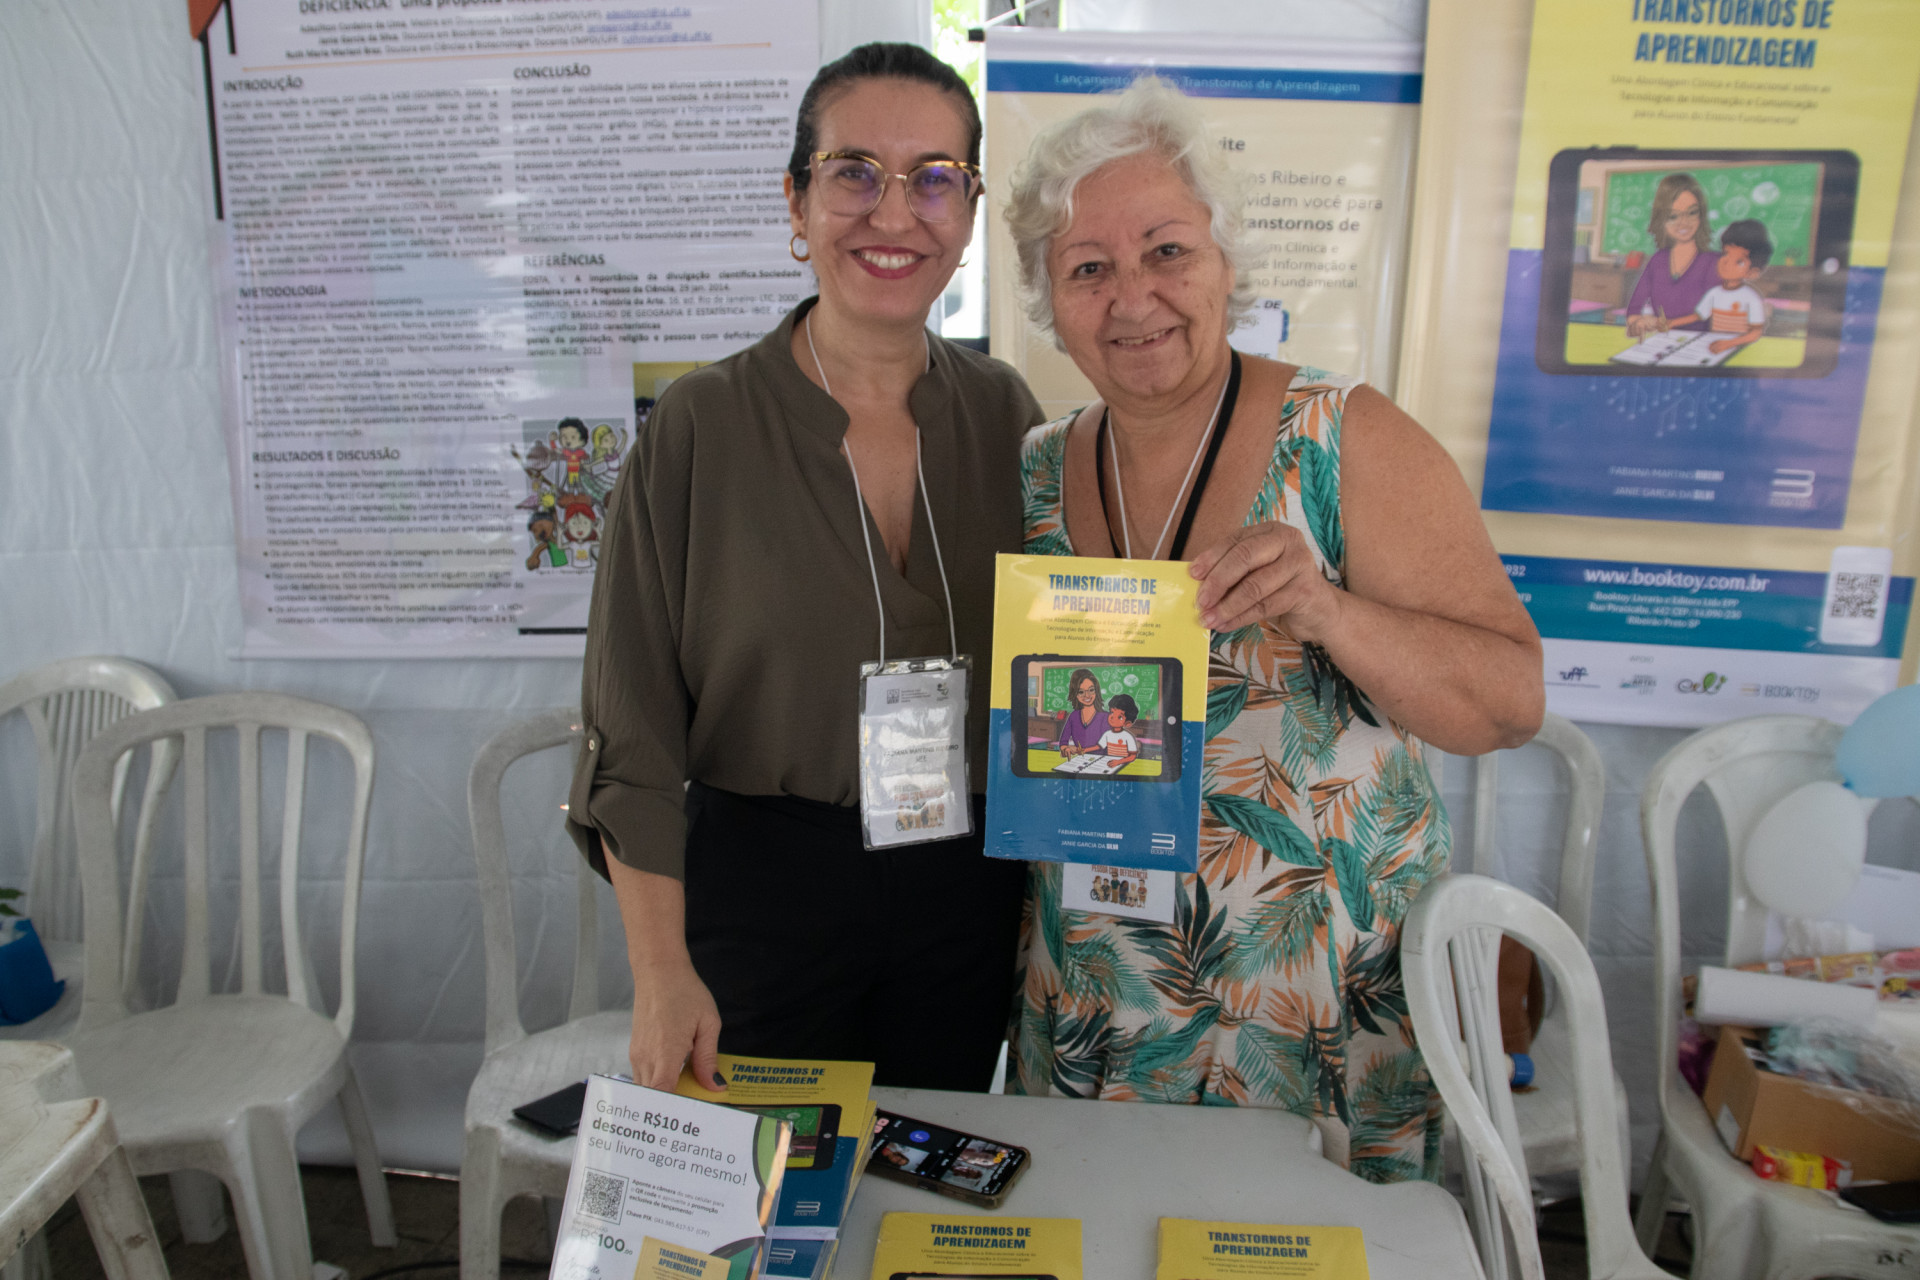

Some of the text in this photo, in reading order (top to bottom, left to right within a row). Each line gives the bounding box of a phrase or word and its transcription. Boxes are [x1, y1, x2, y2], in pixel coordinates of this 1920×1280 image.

[1631, 0, 1835, 28] TRANSTORNOS DE
[1634, 31, 1818, 69] APRENDIZAGEM
[513, 62, 591, 79] CONCLUSÃO
[222, 75, 304, 91] INTRODUÇÃO
[1055, 73, 1131, 88] Lançamento
[1183, 77, 1253, 90] Transtornos
[1256, 79, 1272, 90] de
[1274, 80, 1361, 95] Aprendizagem
[1272, 170, 1332, 185] Ribeiro
[1336, 175, 1346, 185] e
[1304, 194, 1342, 209] você
[1347, 197, 1384, 211] para
[1339, 218, 1360, 231] de
[1285, 241, 1327, 253] Clínica
[523, 253, 605, 267] REFERÊNCIAS
[1273, 258, 1359, 272] Informação e
[239, 284, 328, 297] METODOLOGIA
[252, 449, 323, 462] RESULTADOS
[335, 446, 400, 461] DISCUSSÃO
[1048, 574, 1157, 595] TRANSTORNOS DE
[1584, 566, 1770, 593] www.booktoy.com.br
[1052, 594, 1150, 615] APRENDIZAGEM
[1764, 684, 1820, 701] BOOKTOY
[1057, 828, 1080, 837] FABIANA
[732, 1063, 825, 1076] TRANSTORNOS DE
[731, 1073, 818, 1084] APRENDIZAGEM
[596, 1099, 700, 1137] Ganhe R$10 de
[592, 1116, 736, 1164] desconto e garanta o
[588, 1135, 747, 1187] seu livro agora mesmo!
[631, 1179, 651, 1189] Aponte
[656, 1184, 676, 1195] câmera
[712, 1198, 725, 1207] para
[635, 1186, 644, 1194] QR
[644, 1189, 657, 1198] code
[691, 1203, 719, 1215] promoção
[653, 1200, 660, 1208] de
[626, 1209, 642, 1218] Chave
[930, 1224, 1031, 1237] TRANSTORNOS DE
[1208, 1231, 1312, 1246] TRANSTORNOS DE
[933, 1235, 1026, 1249] APRENDIZAGEM
[659, 1247, 707, 1268] TRANSTORNOS DE
[1213, 1243, 1308, 1258] APRENDIZAGEM
[658, 1257, 702, 1277] APRENDIZAGEM
